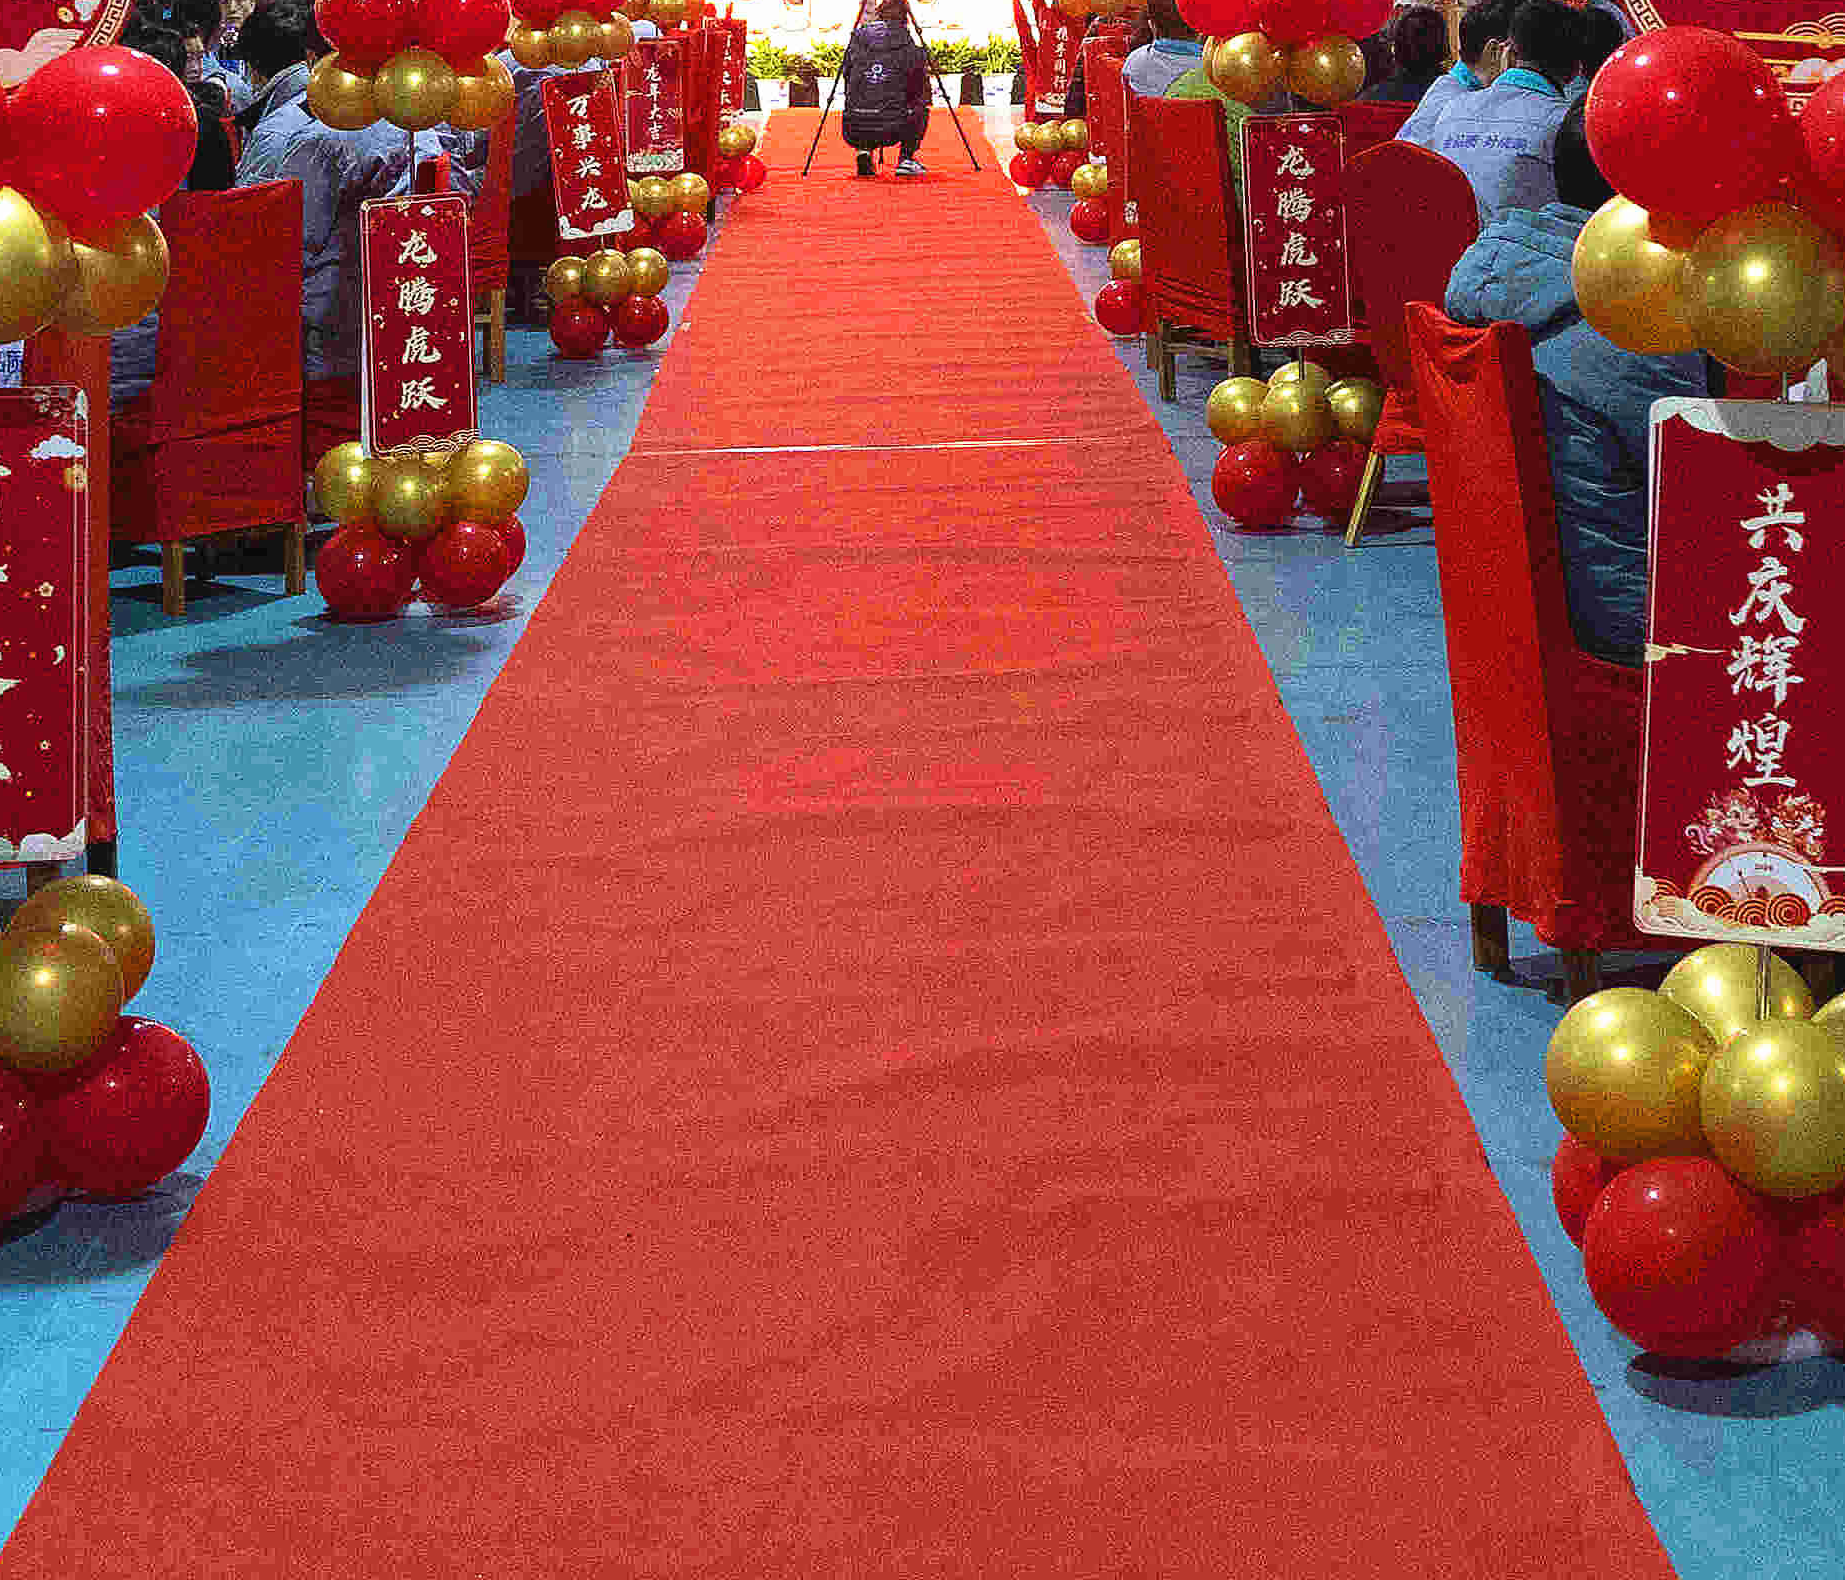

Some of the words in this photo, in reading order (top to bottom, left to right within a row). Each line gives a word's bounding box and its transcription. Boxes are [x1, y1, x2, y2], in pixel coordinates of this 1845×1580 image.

[566, 93, 608, 210] 万事兴龙
[643, 63, 664, 141] 龙年大吉
[1276, 144, 1324, 308] 龙腾虎跃
[397, 227, 449, 410] 龙腾虎跃
[1726, 482, 1807, 788] 共庆辉煌
